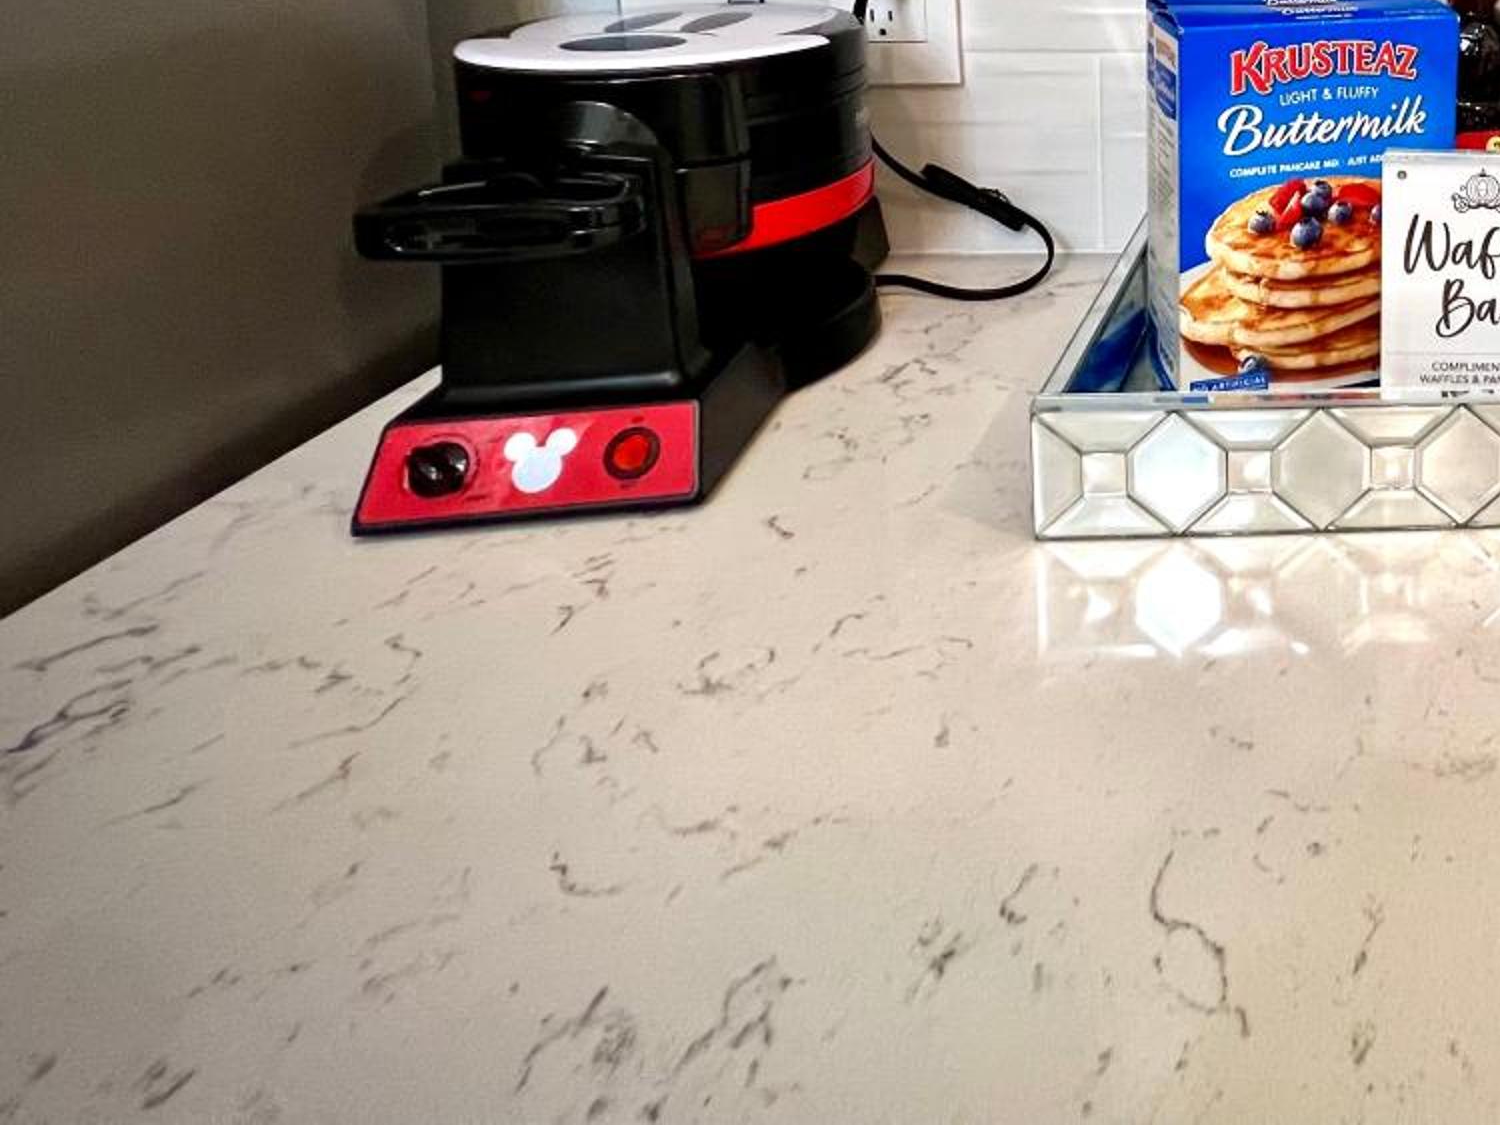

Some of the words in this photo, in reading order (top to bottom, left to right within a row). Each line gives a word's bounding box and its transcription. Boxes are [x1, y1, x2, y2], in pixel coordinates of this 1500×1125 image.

[1231, 40, 1418, 95] KRUSTEAZ
[1280, 88, 1318, 106] LIGHT
[1322, 88, 1333, 100] &
[1337, 86, 1379, 100] FLUFFY
[1217, 95, 1427, 156] Buttermilk
[1229, 163, 1277, 178] COMPLETE
[1279, 160, 1321, 173] PANCAKE
[1323, 159, 1339, 169] MIX
[1347, 156, 1368, 166] JUST
[1419, 374, 1469, 384] WAFFLES
[1471, 375, 1480, 384] &
